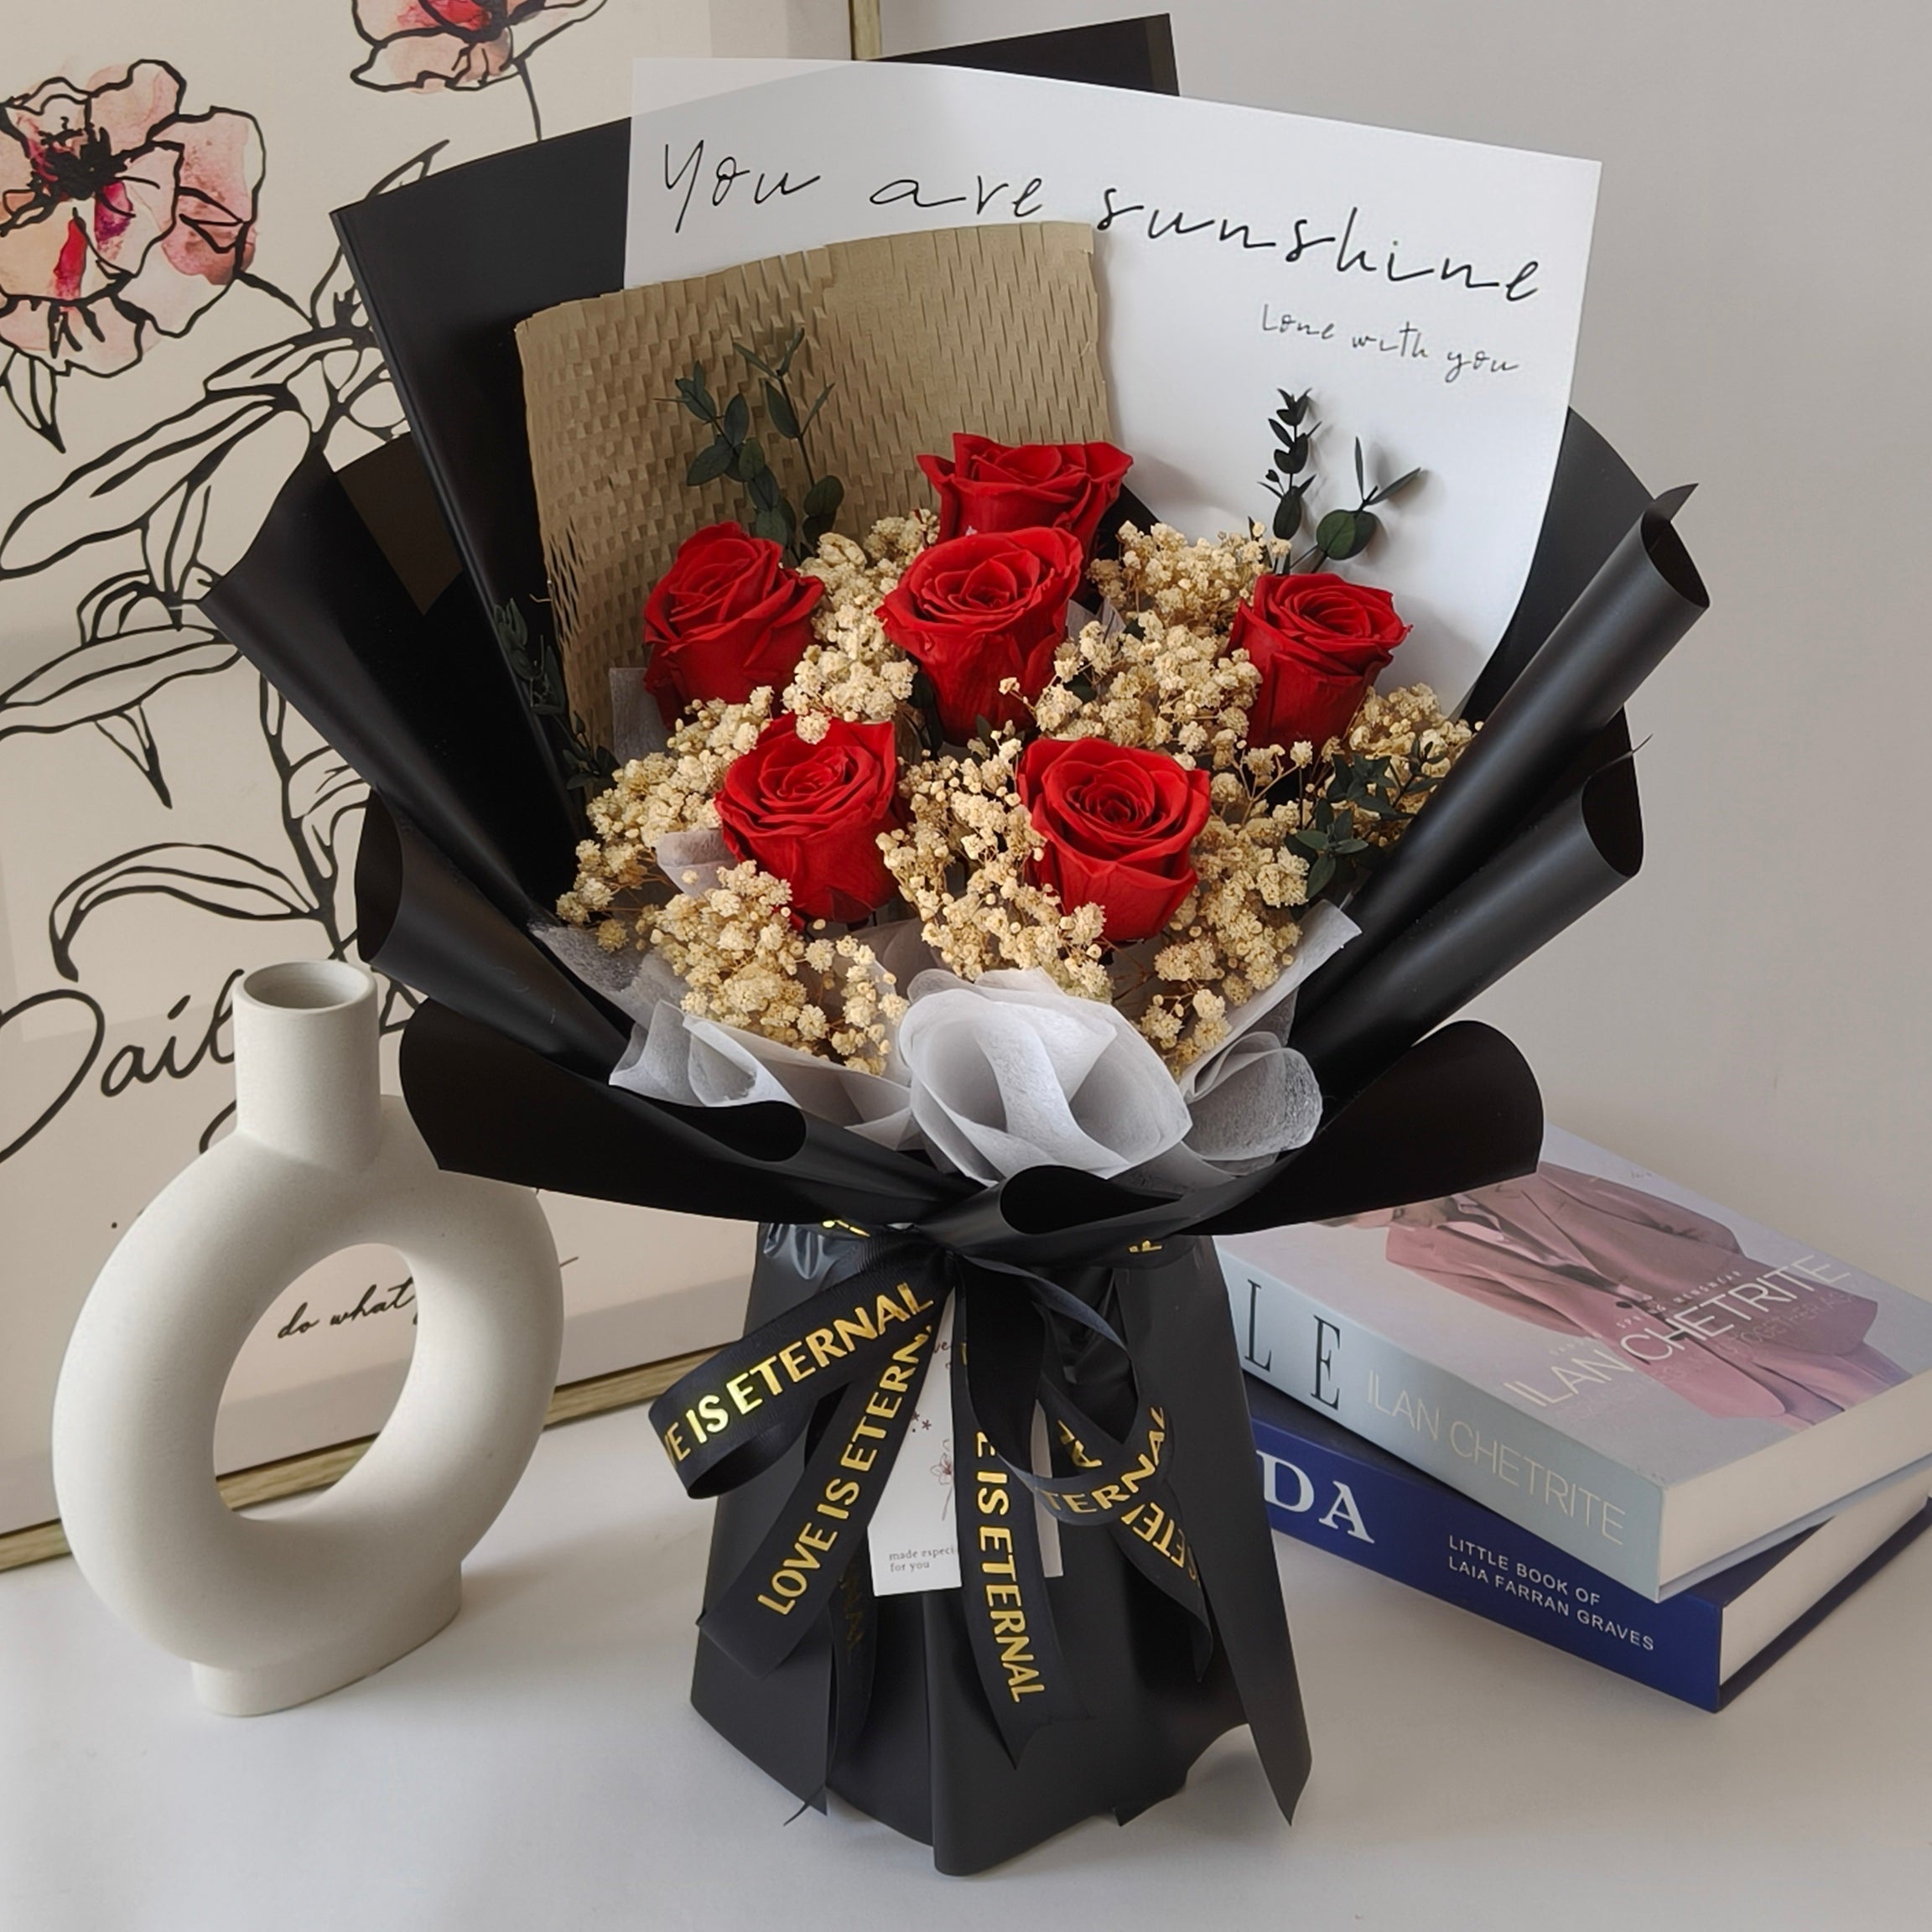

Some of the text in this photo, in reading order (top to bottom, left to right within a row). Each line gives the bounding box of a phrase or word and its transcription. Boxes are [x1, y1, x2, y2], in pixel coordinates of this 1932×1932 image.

[664, 139, 1540, 302] You are sunshine
[1351, 322, 1428, 358] with
[1445, 348, 1519, 383] you
[278, 1301, 319, 1339] do
[685, 1394, 730, 1444] IS
[725, 1282, 934, 1415] ETERNAL
[1504, 1348, 1635, 1407] ILAN
[1620, 1254, 1851, 1363] CHETRITE
[757, 1522, 839, 1615] LOVE
[817, 1478, 860, 1520] IS
[840, 1325, 932, 1472] ETERN
[977, 1472, 1010, 1515] IS
[1368, 1369, 1627, 1547] ILAN CHETRITE
[979, 1526, 1046, 1703] ETERNAL
[1448, 1555, 1654, 1651] LAIA FARRAN GRAVES
[1449, 1535, 1601, 1607] LITTLE BOOK OF
